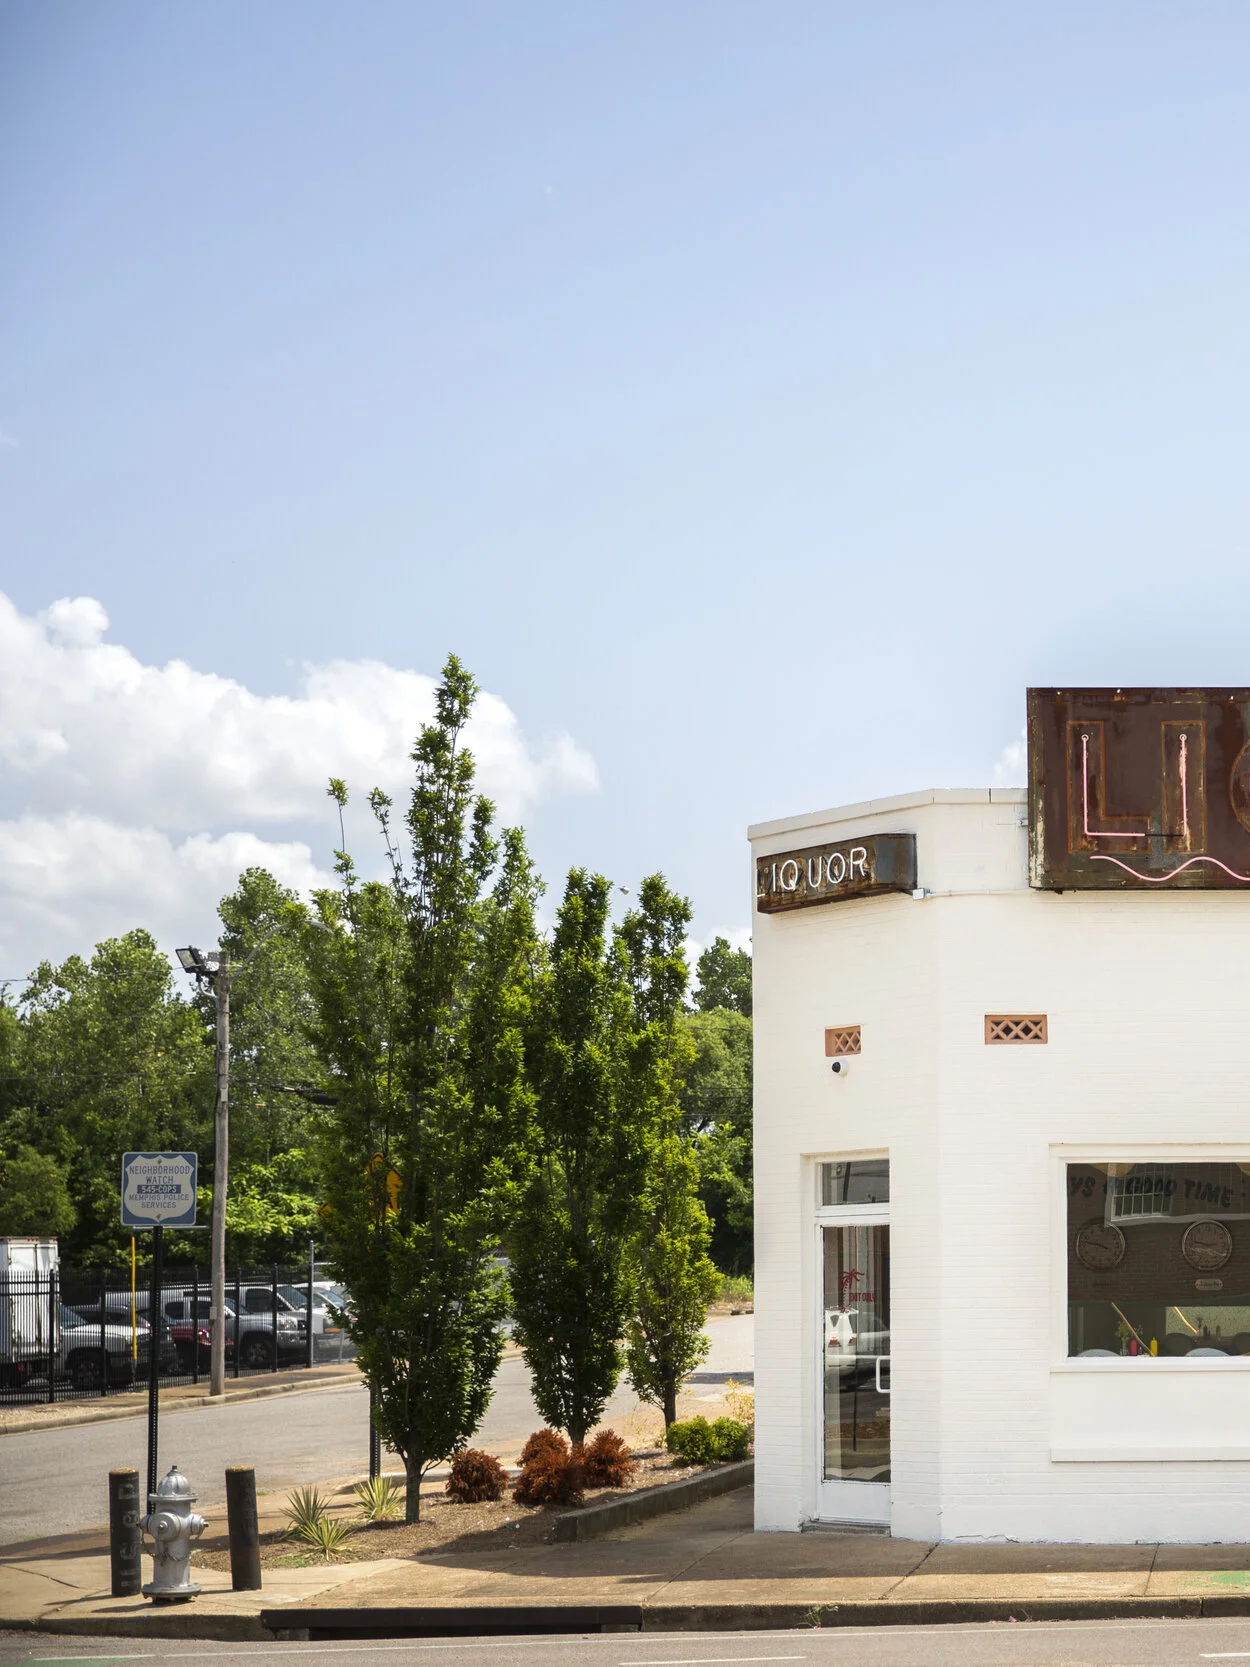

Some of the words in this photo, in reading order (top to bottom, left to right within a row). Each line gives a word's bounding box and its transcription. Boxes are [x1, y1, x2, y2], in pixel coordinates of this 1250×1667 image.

[129, 1165, 191, 1175] NEIGHBORHOOD
[145, 1175, 174, 1185] WATCH
[141, 1185, 177, 1193] 545-COPS
[128, 1193, 161, 1201] MEMPHIS
[163, 1193, 189, 1201] POLICE
[141, 1201, 177, 1209] SERVICES
